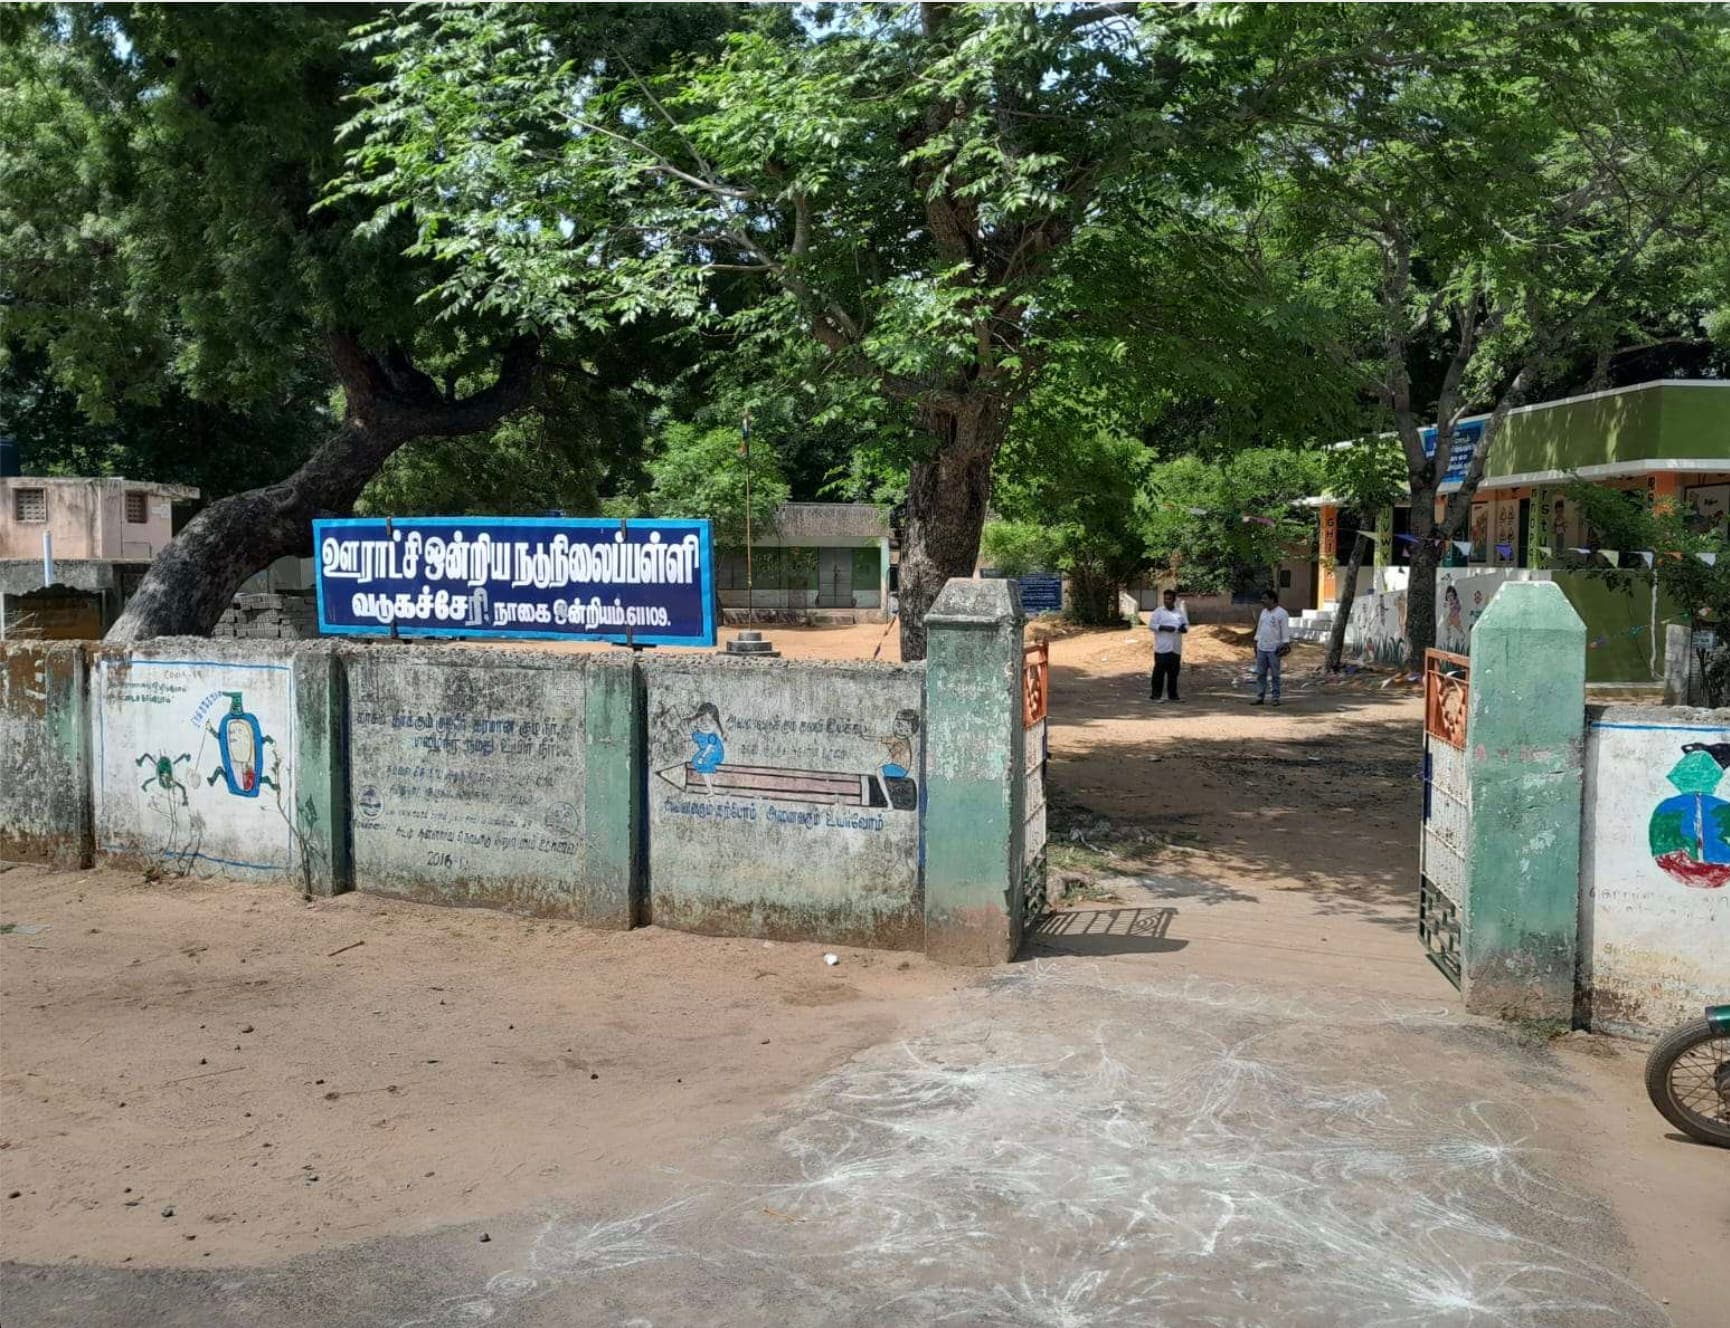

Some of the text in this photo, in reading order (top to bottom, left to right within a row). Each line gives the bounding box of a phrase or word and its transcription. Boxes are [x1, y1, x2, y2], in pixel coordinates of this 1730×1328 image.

[322, 529, 700, 589] ஊராட்சி ஒன்றிய நடுநிலைப்பள்ளி
[493, 601, 552, 626] நாகை
